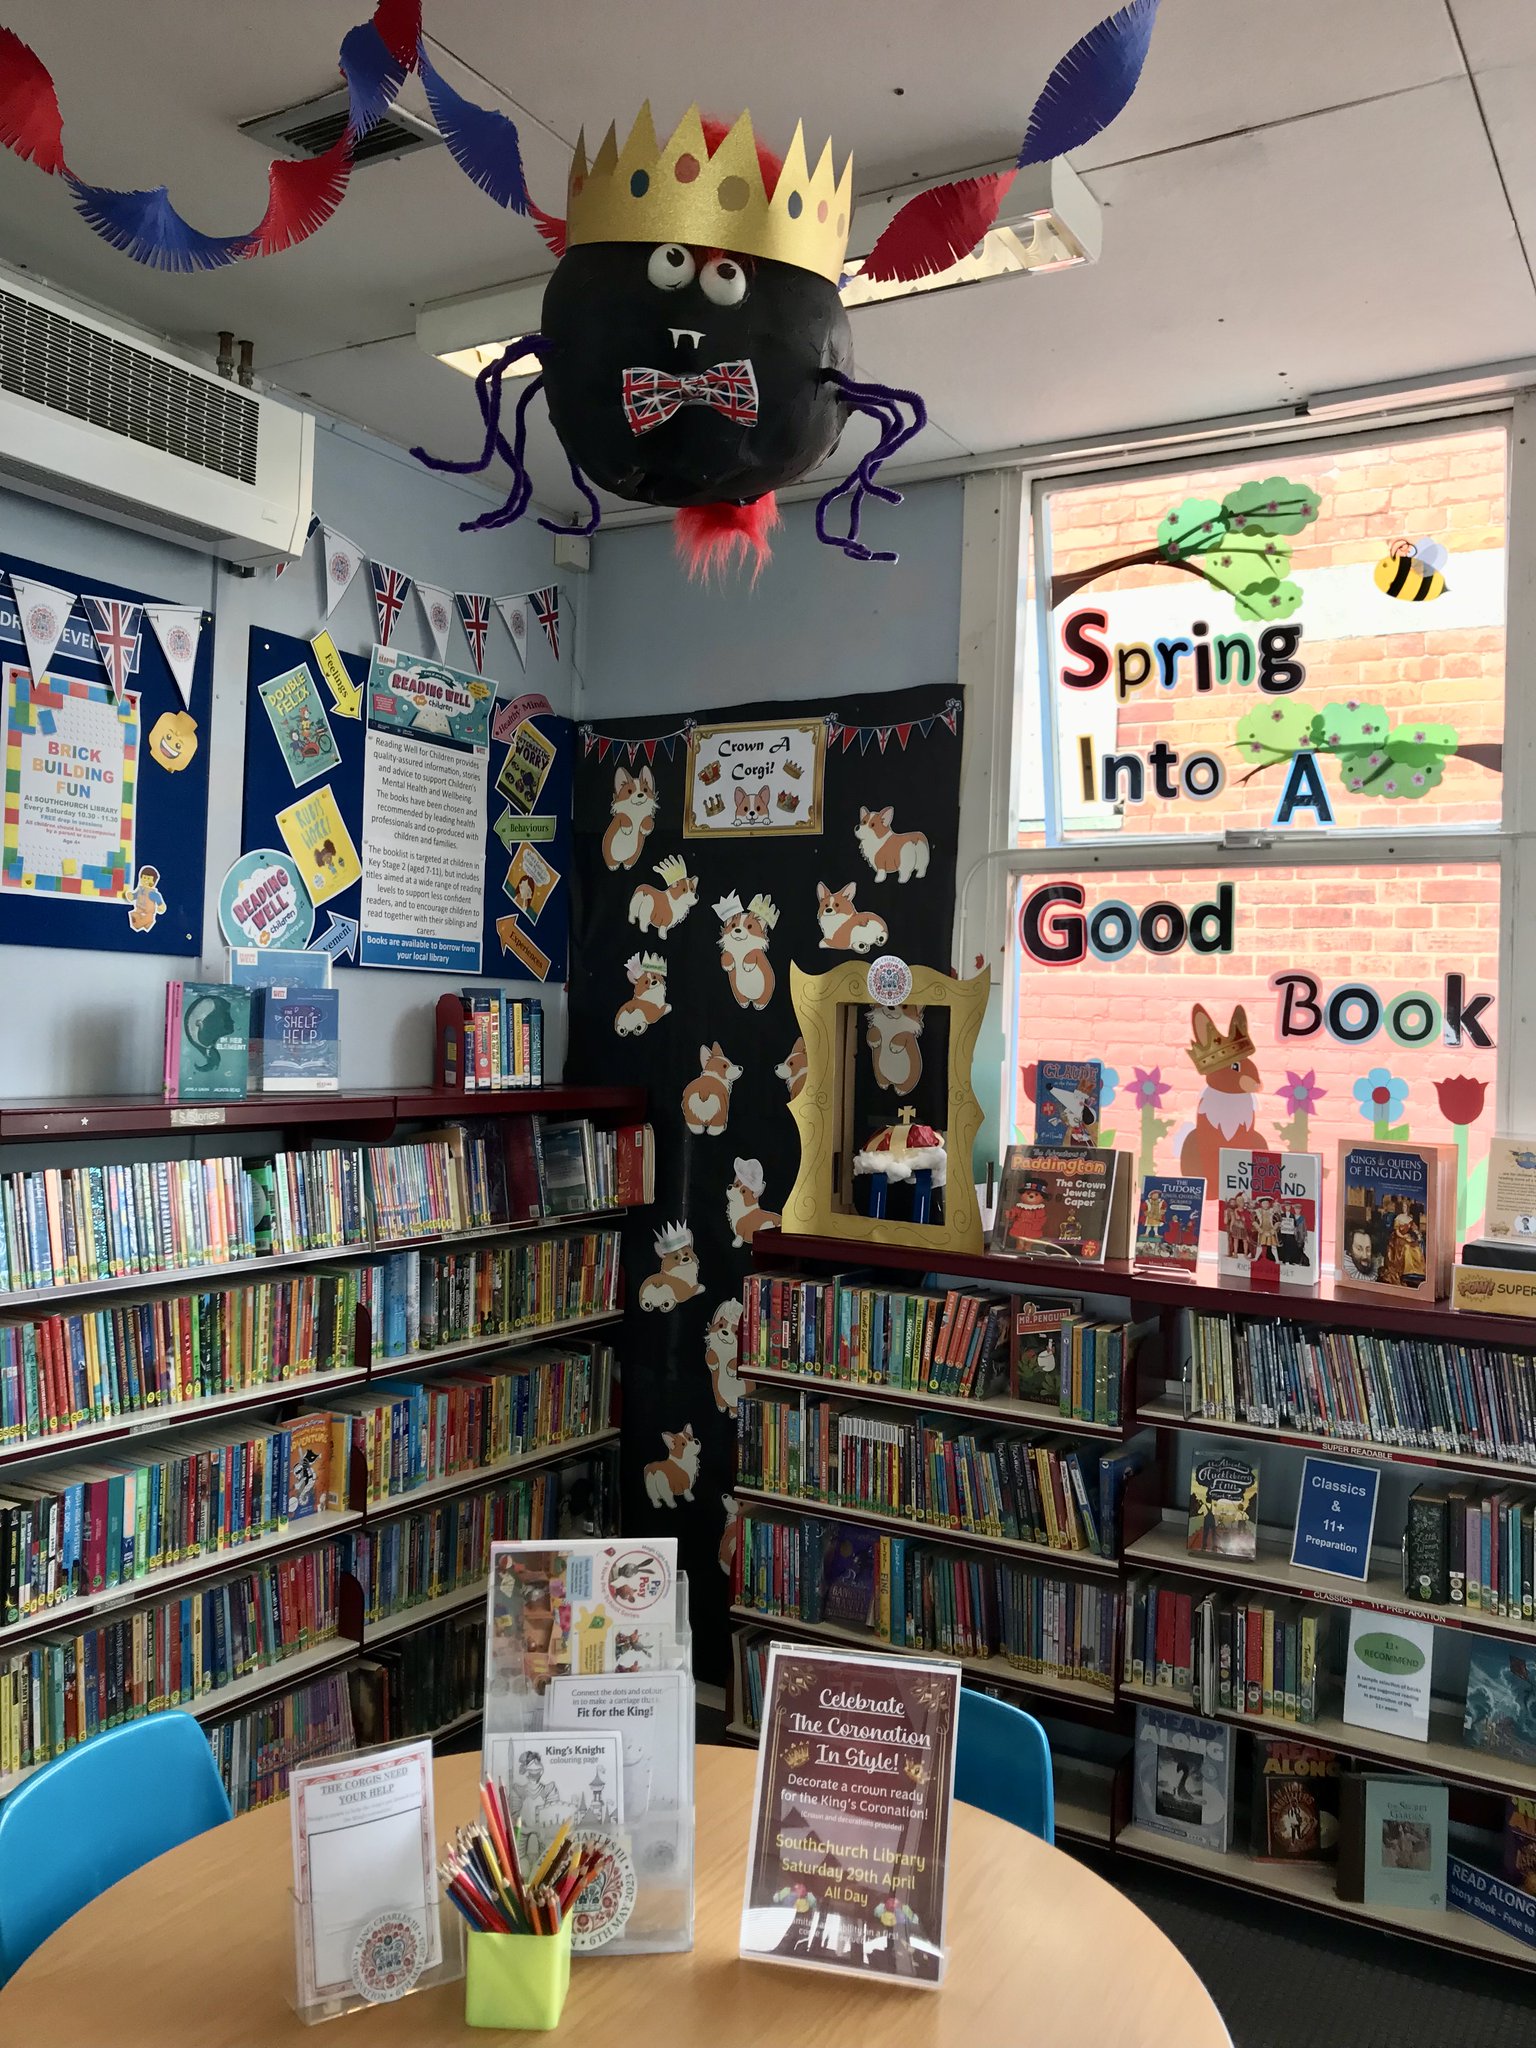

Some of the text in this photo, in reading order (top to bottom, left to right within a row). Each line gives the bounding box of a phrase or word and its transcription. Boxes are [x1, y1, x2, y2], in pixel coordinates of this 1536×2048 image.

[1060, 607, 1307, 702] Spring
[325, 653, 348, 698] Feelings
[268, 672, 307, 706] DOUBLE
[392, 673, 443, 700] READING
[446, 689, 470, 708] WELL
[276, 686, 311, 717] FELIX
[428, 700, 453, 712] children
[498, 710, 520, 734] Healthy
[48, 741, 101, 763] BRICK
[375, 737, 479, 769] Reading Well for Children provides
[516, 743, 549, 770] WORRY
[718, 736, 790, 757] Crown A
[32, 758, 114, 783] BUILDING
[373, 751, 480, 781] quality-assured information, stories
[731, 762, 775, 780] Corgi!
[56, 780, 91, 798] FUN
[1077, 734, 1337, 825] Into A
[24, 803, 44, 813] Every
[46, 805, 76, 817] Saturday
[78, 811, 95, 819] 10.30
[35, 796, 88, 809] SOUTHCHURCH
[90, 805, 118, 814] LIBRARY
[510, 824, 549, 832] Behaviours
[233, 868, 290, 925] READING
[251, 894, 290, 931] WELL
[270, 910, 296, 934] children
[1019, 880, 1235, 967] Good
[367, 935, 388, 945] Books
[389, 938, 400, 946] are
[401, 939, 429, 949] available
[439, 943, 460, 952] borrow
[461, 944, 475, 953] from
[509, 931, 544, 969] Experiences
[397, 951, 450, 964] your local library
[1268, 968, 1497, 1050] Book
[283, 1015, 318, 1028] SHELF
[283, 1030, 317, 1044] HELP
[1042, 1063, 1099, 1080] CLAUDE
[1011, 1155, 1106, 1176] Paddington
[1238, 1162, 1286, 1178] STORY
[1350, 1155, 1421, 1170] KINGS QUEENS
[1350, 1166, 1422, 1181] OF ENGLAND
[1056, 1179, 1106, 1190] The Crown
[1063, 1189, 1096, 1198] Jewels
[1162, 1184, 1201, 1194] TUDORS
[1227, 1175, 1306, 1197] ENGLAND
[1064, 1198, 1095, 1208] Caper
[1019, 1315, 1033, 1324] MR.
[905, 1319, 913, 1358] SHOCKWAVE
[1322, 1443, 1392, 1459] SUPER READABLE
[1311, 1476, 1366, 1497] Classics
[1331, 1500, 1341, 1512] &
[1323, 1519, 1345, 1532] 11+
[1306, 1534, 1358, 1554] Preparation
[637, 1576, 649, 1597] Posy
[1313, 1591, 1352, 1604] CLASSICS
[1386, 1605, 1446, 1622] PREPARATION
[1364, 1649, 1419, 1667] RECOMMEND
[571, 1689, 599, 1697] Connect
[820, 1688, 905, 1716] Celebrate
[577, 1706, 654, 1718] Fit for the King!
[790, 1712, 931, 1747] The Coronation
[546, 1746, 605, 1756] King's Knight
[1140, 1723, 1225, 1762] ALONG
[549, 1756, 599, 1765] colouring page
[816, 1744, 898, 1774] In Style!
[320, 1767, 408, 1795] THE CORGIS NEED
[788, 1774, 923, 1805] Decorate a crown ready
[338, 1784, 394, 1805] YOUR HELP
[780, 1788, 928, 1820] for the King's Coronation!
[775, 1834, 926, 1872] Southchurch Library
[782, 1858, 915, 1890] Saturday 29th April
[625, 1873, 634, 1902] 2023
[825, 1886, 868, 1908] All Day
[1452, 1863, 1536, 1918] READ ALONG
[611, 1907, 630, 1927] MAY
[1451, 1884, 1473, 1903] Story
[1474, 1896, 1496, 1916] Book
[1503, 1911, 1523, 1928] Free
[1525, 1922, 1534, 1935] to
